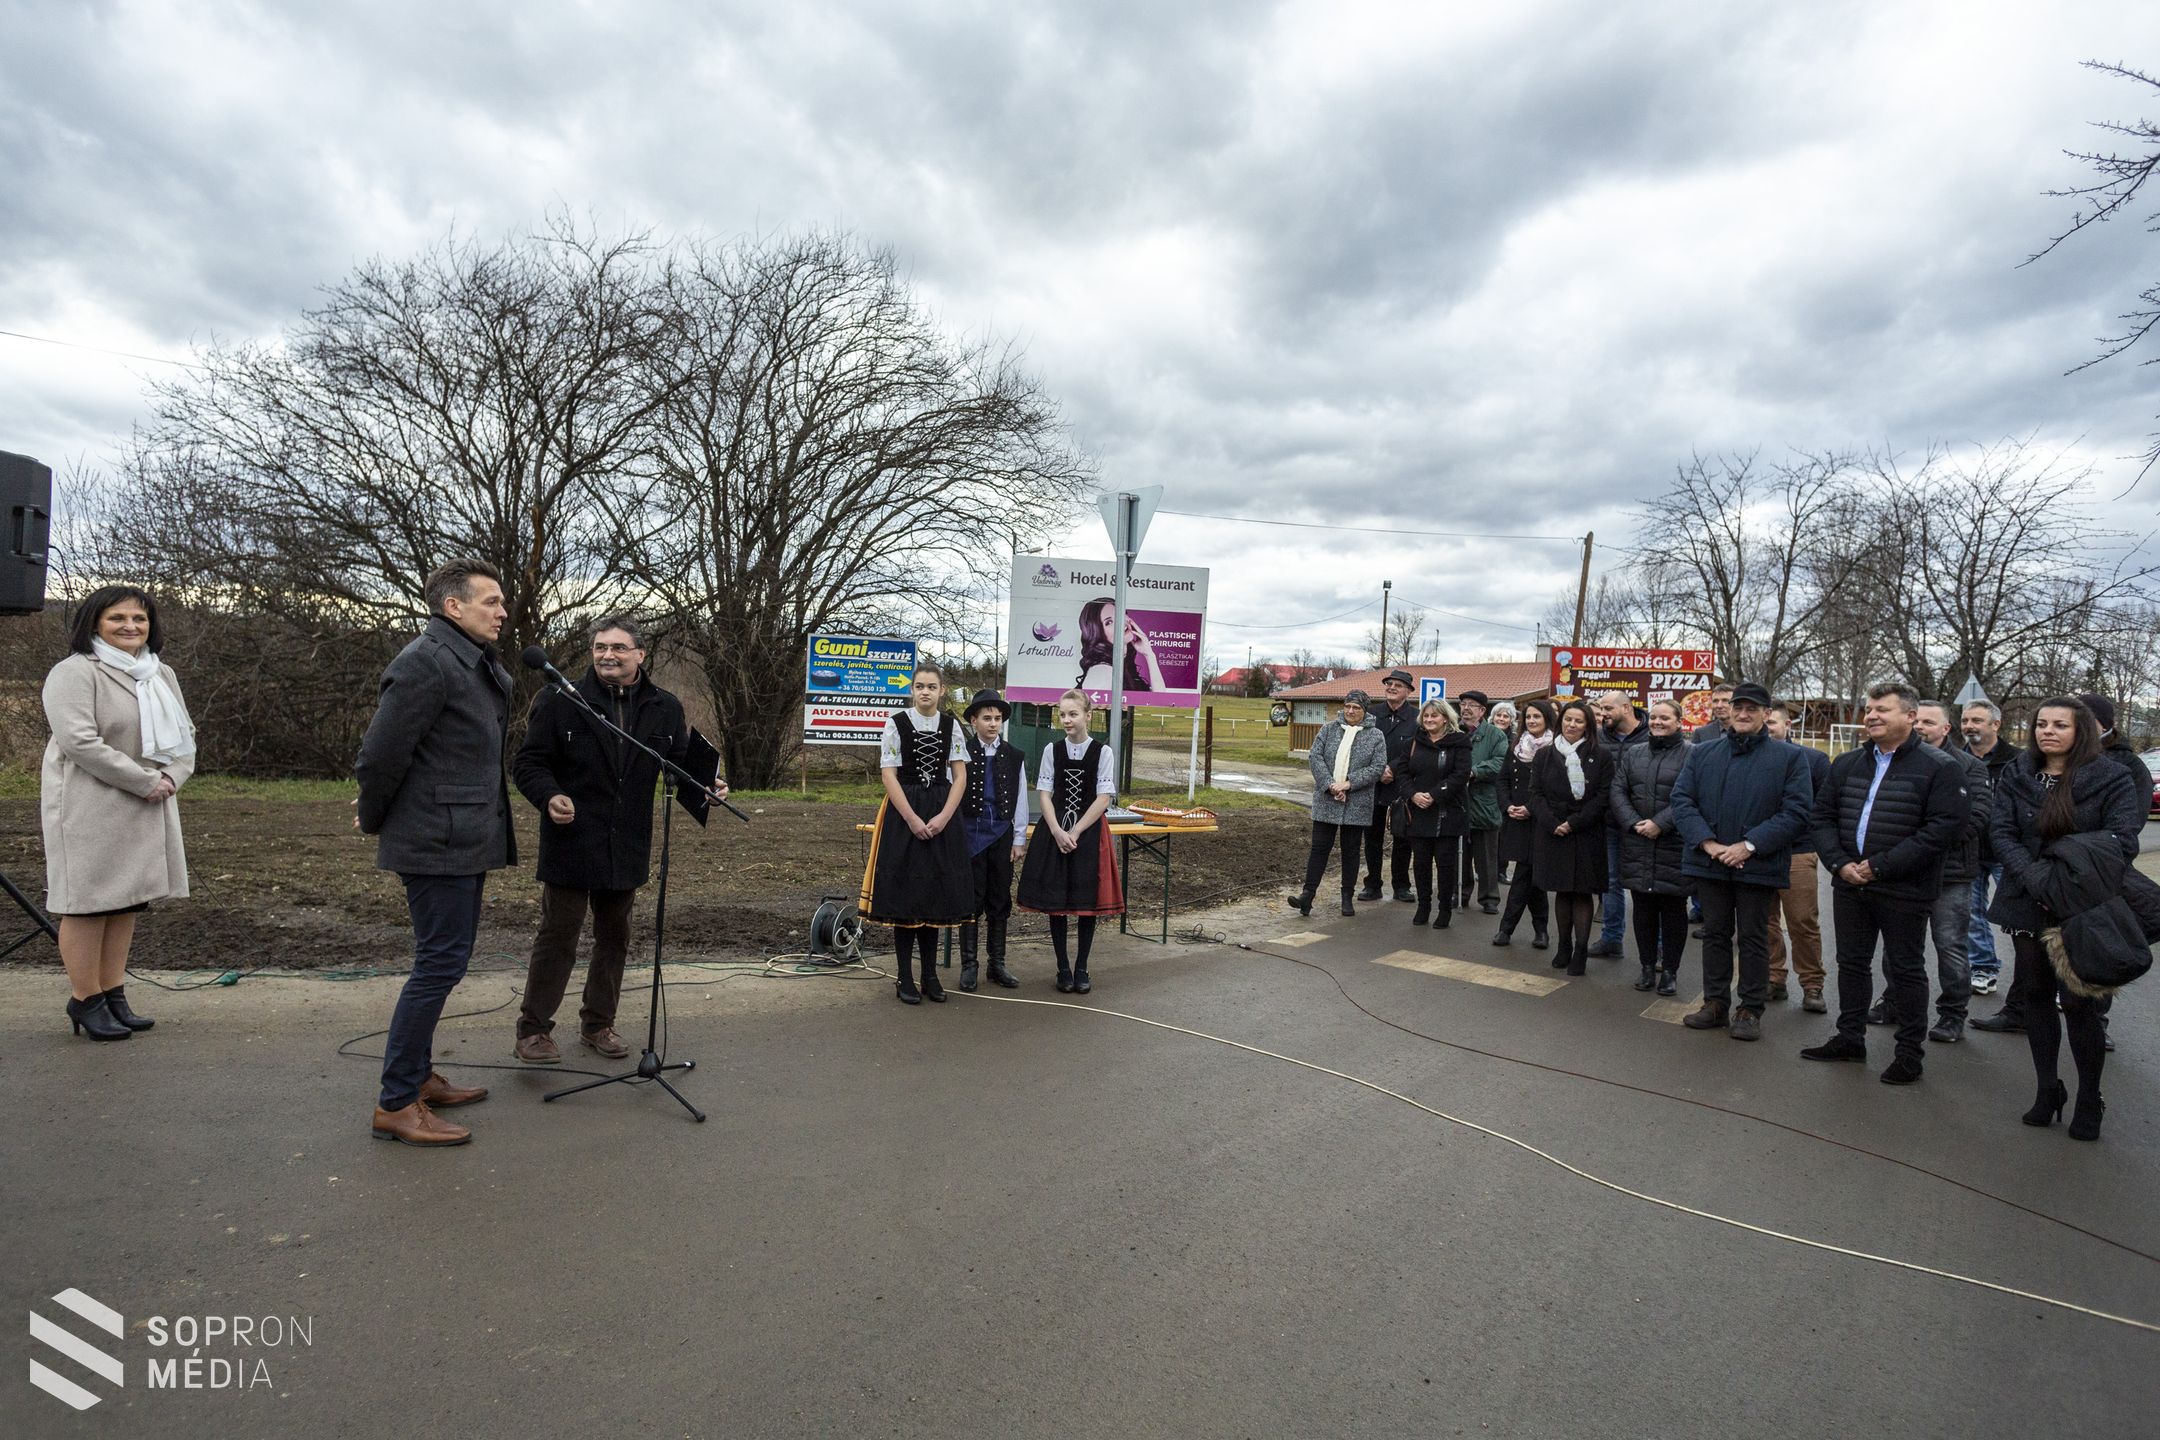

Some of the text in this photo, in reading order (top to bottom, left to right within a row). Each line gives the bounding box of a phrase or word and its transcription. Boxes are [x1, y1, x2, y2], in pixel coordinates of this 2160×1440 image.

[1070, 571, 1107, 586] Hotel
[1149, 631, 1197, 640] PLASTISCHE
[1149, 640, 1191, 649] CHIRURGIE
[1018, 643, 1074, 658] LotusMed
[1582, 654, 1683, 669] KISVENDÉGLŐ
[1577, 671, 1610, 680] Reggeli
[1581, 680, 1639, 688] Frissensültek
[1649, 673, 1711, 690] PIZZA
[1426, 682, 1441, 701] P
[869, 697, 886, 705] CAR
[887, 698, 905, 706] KFT.
[812, 709, 889, 717] AUTOSERVICE
